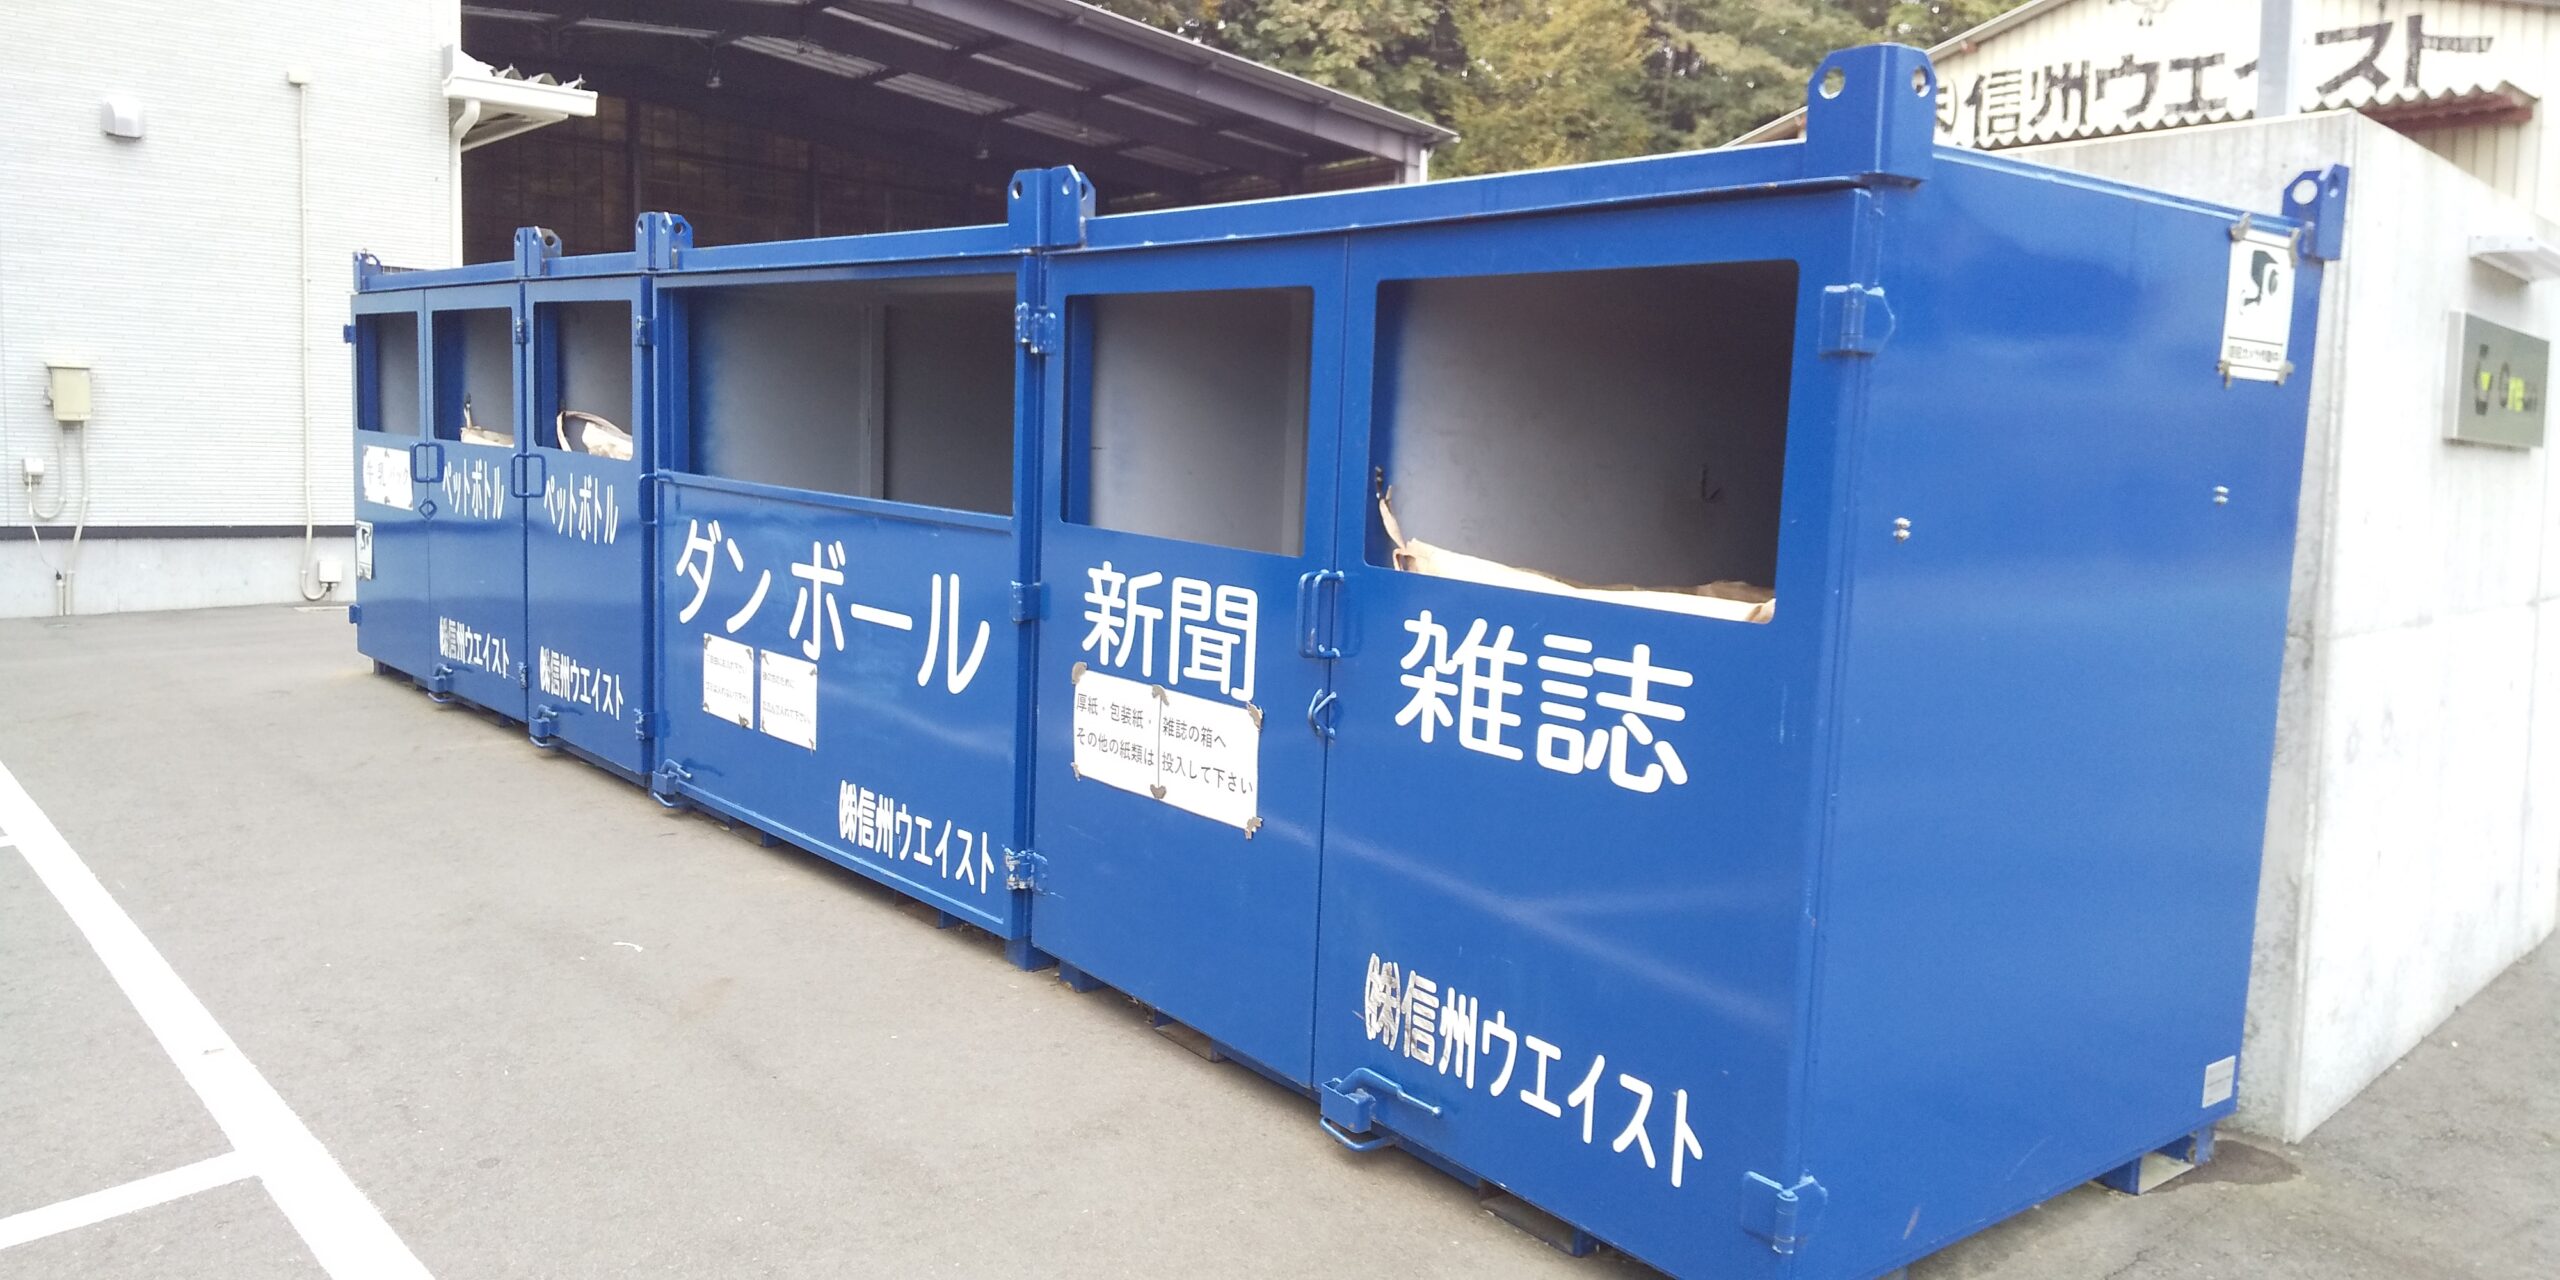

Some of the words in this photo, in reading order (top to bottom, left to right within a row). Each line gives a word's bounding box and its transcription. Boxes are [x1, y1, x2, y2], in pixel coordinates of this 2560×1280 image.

[442, 458, 505, 520] ペットボトル
[543, 472, 619, 545] ペットボトル
[676, 519, 991, 695] ダンボール
[1082, 561, 1259, 702] 新聞
[1162, 717, 1226, 748] 雑誌の箱へ
[1395, 610, 1694, 793] 雑誌
[1077, 727, 1154, 766] その他の紙類は
[1161, 751, 1253, 794] 投入して下さい
